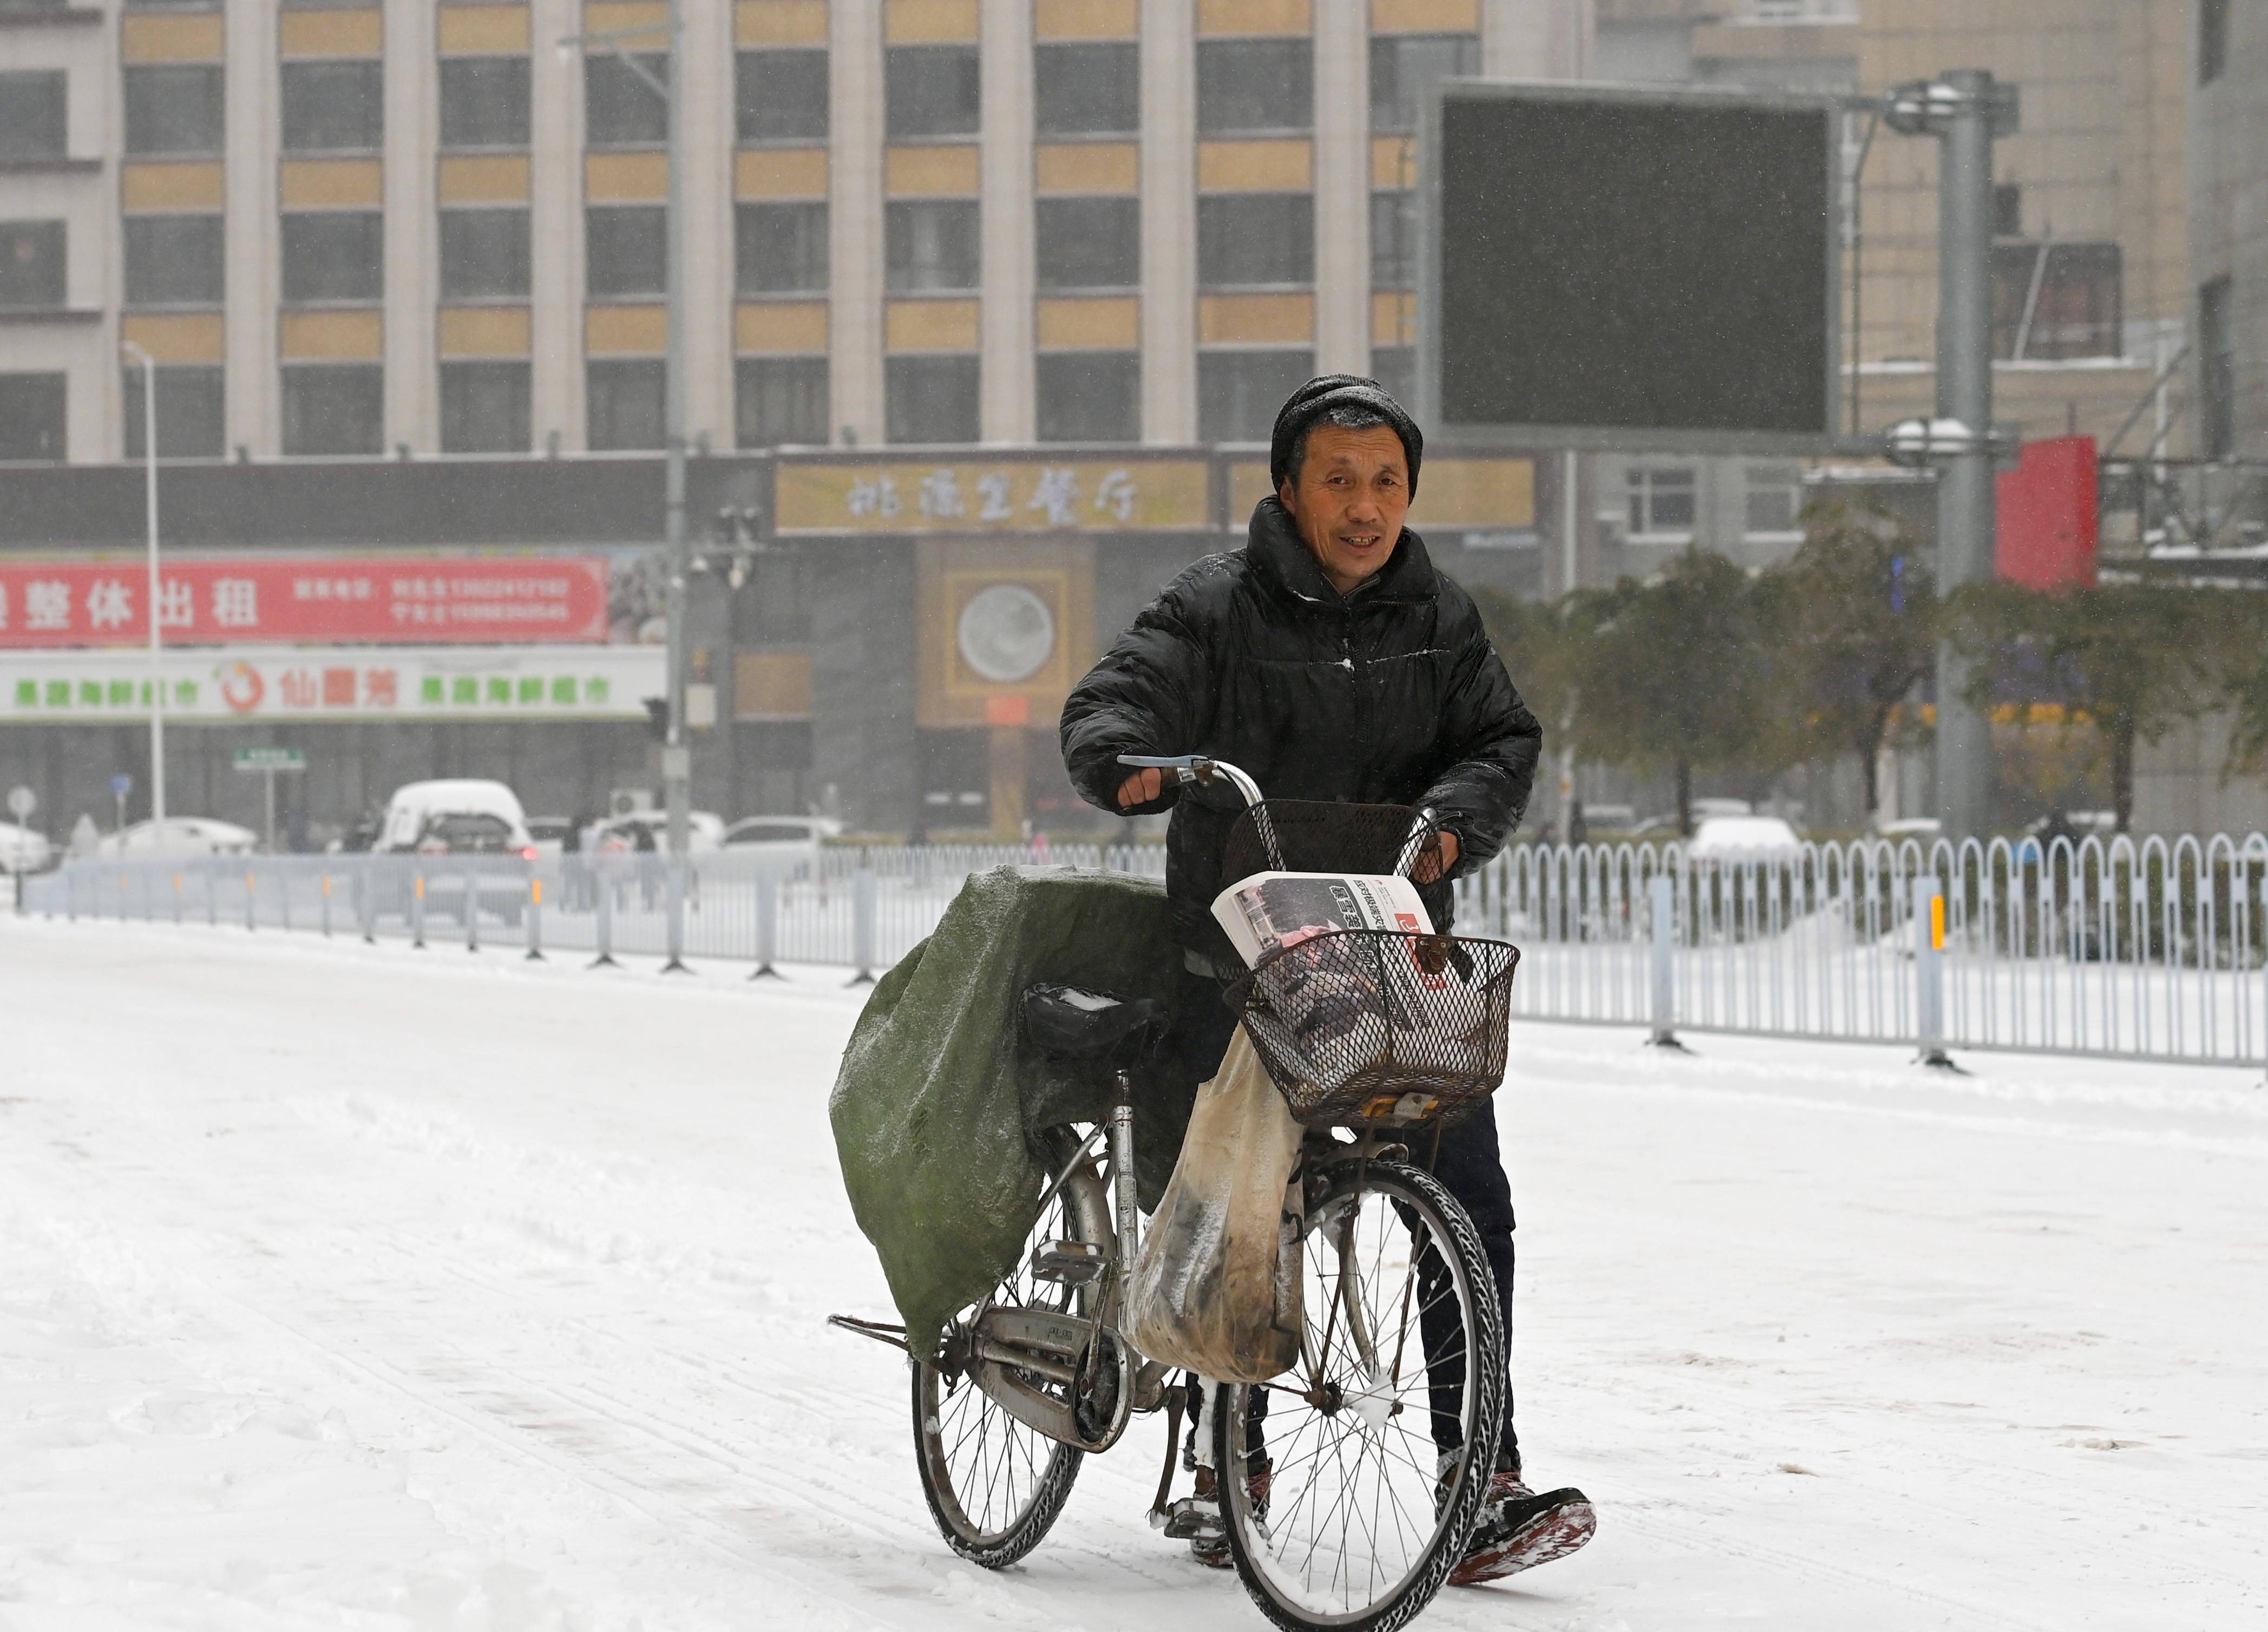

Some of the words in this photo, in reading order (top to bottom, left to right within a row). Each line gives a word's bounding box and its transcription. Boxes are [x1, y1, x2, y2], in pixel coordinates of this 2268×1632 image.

[0, 579, 257, 628] 整体出租
[421, 675, 611, 705] 果蔬海鲜超市
